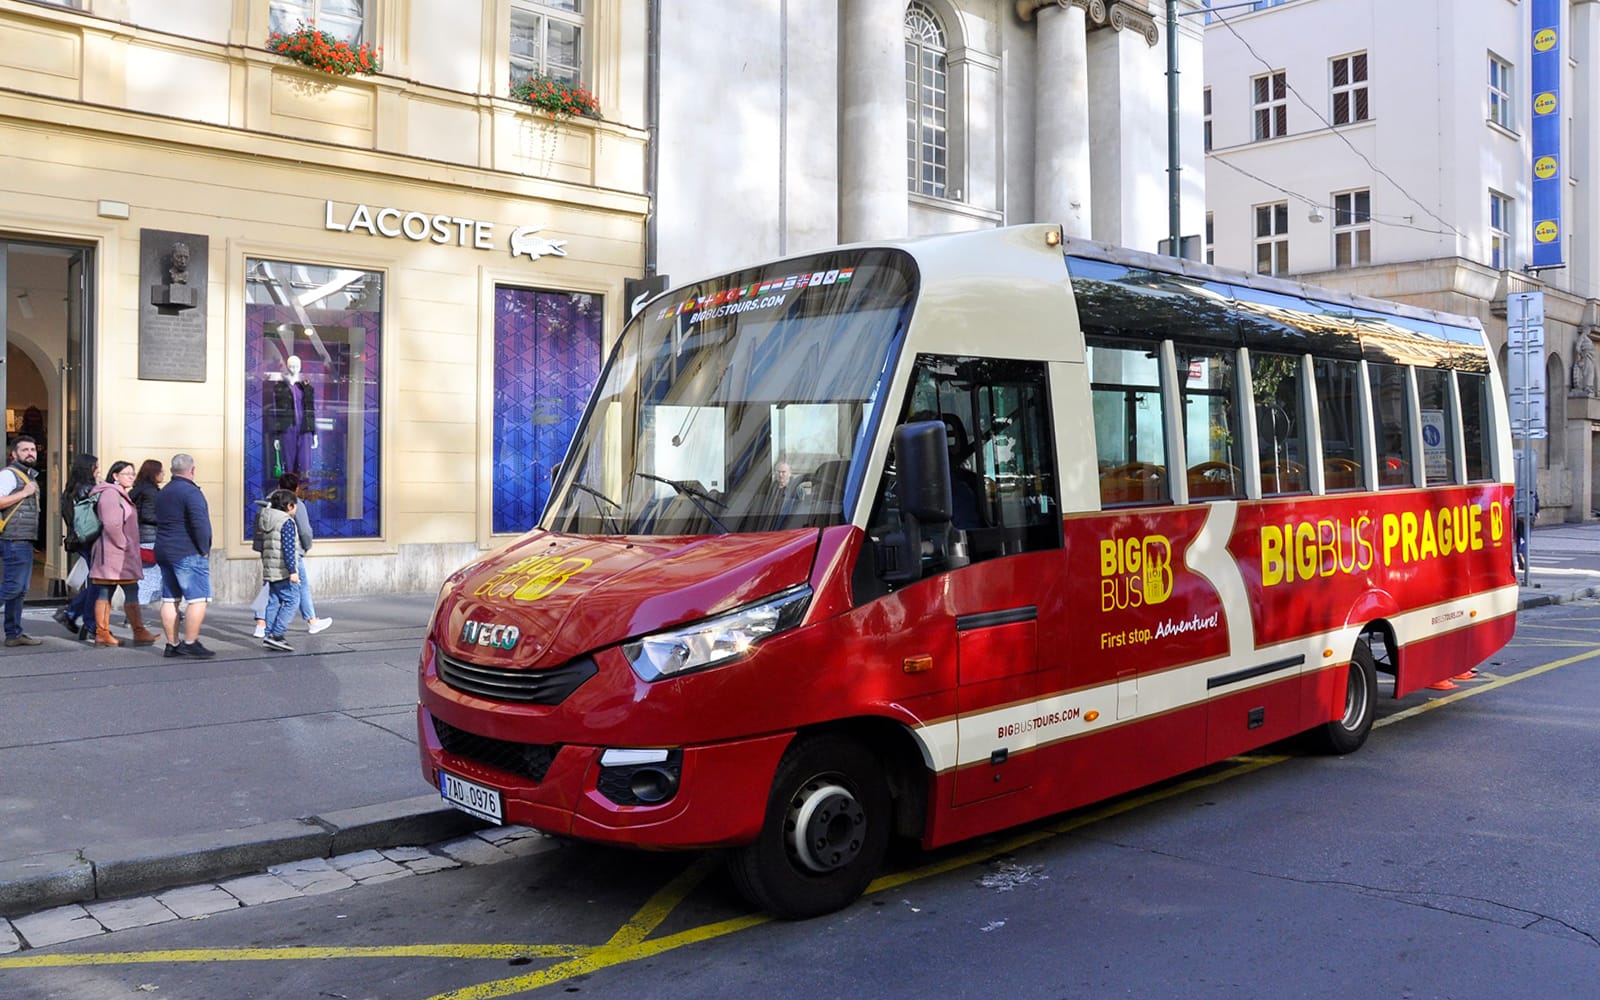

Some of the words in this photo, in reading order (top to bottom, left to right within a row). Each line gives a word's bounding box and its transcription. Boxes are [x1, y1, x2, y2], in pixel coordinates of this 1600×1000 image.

[325, 200, 494, 249] LACOSTE
[689, 295, 786, 324] BIGBUSTOURS.COM
[1382, 504, 1484, 567] PRAGUE
[1100, 537, 1142, 577] BIG
[474, 573, 531, 599] BUS
[1101, 575, 1143, 612] BUS
[462, 620, 520, 650] IVECO
[1101, 632, 1127, 650] First
[1129, 628, 1153, 645] stop.
[1155, 611, 1218, 640] Adventure!
[998, 708, 1080, 738] BIGBUSTOURS.COM
[446, 777, 464, 801] 7AD
[469, 787, 496, 813] 0976
